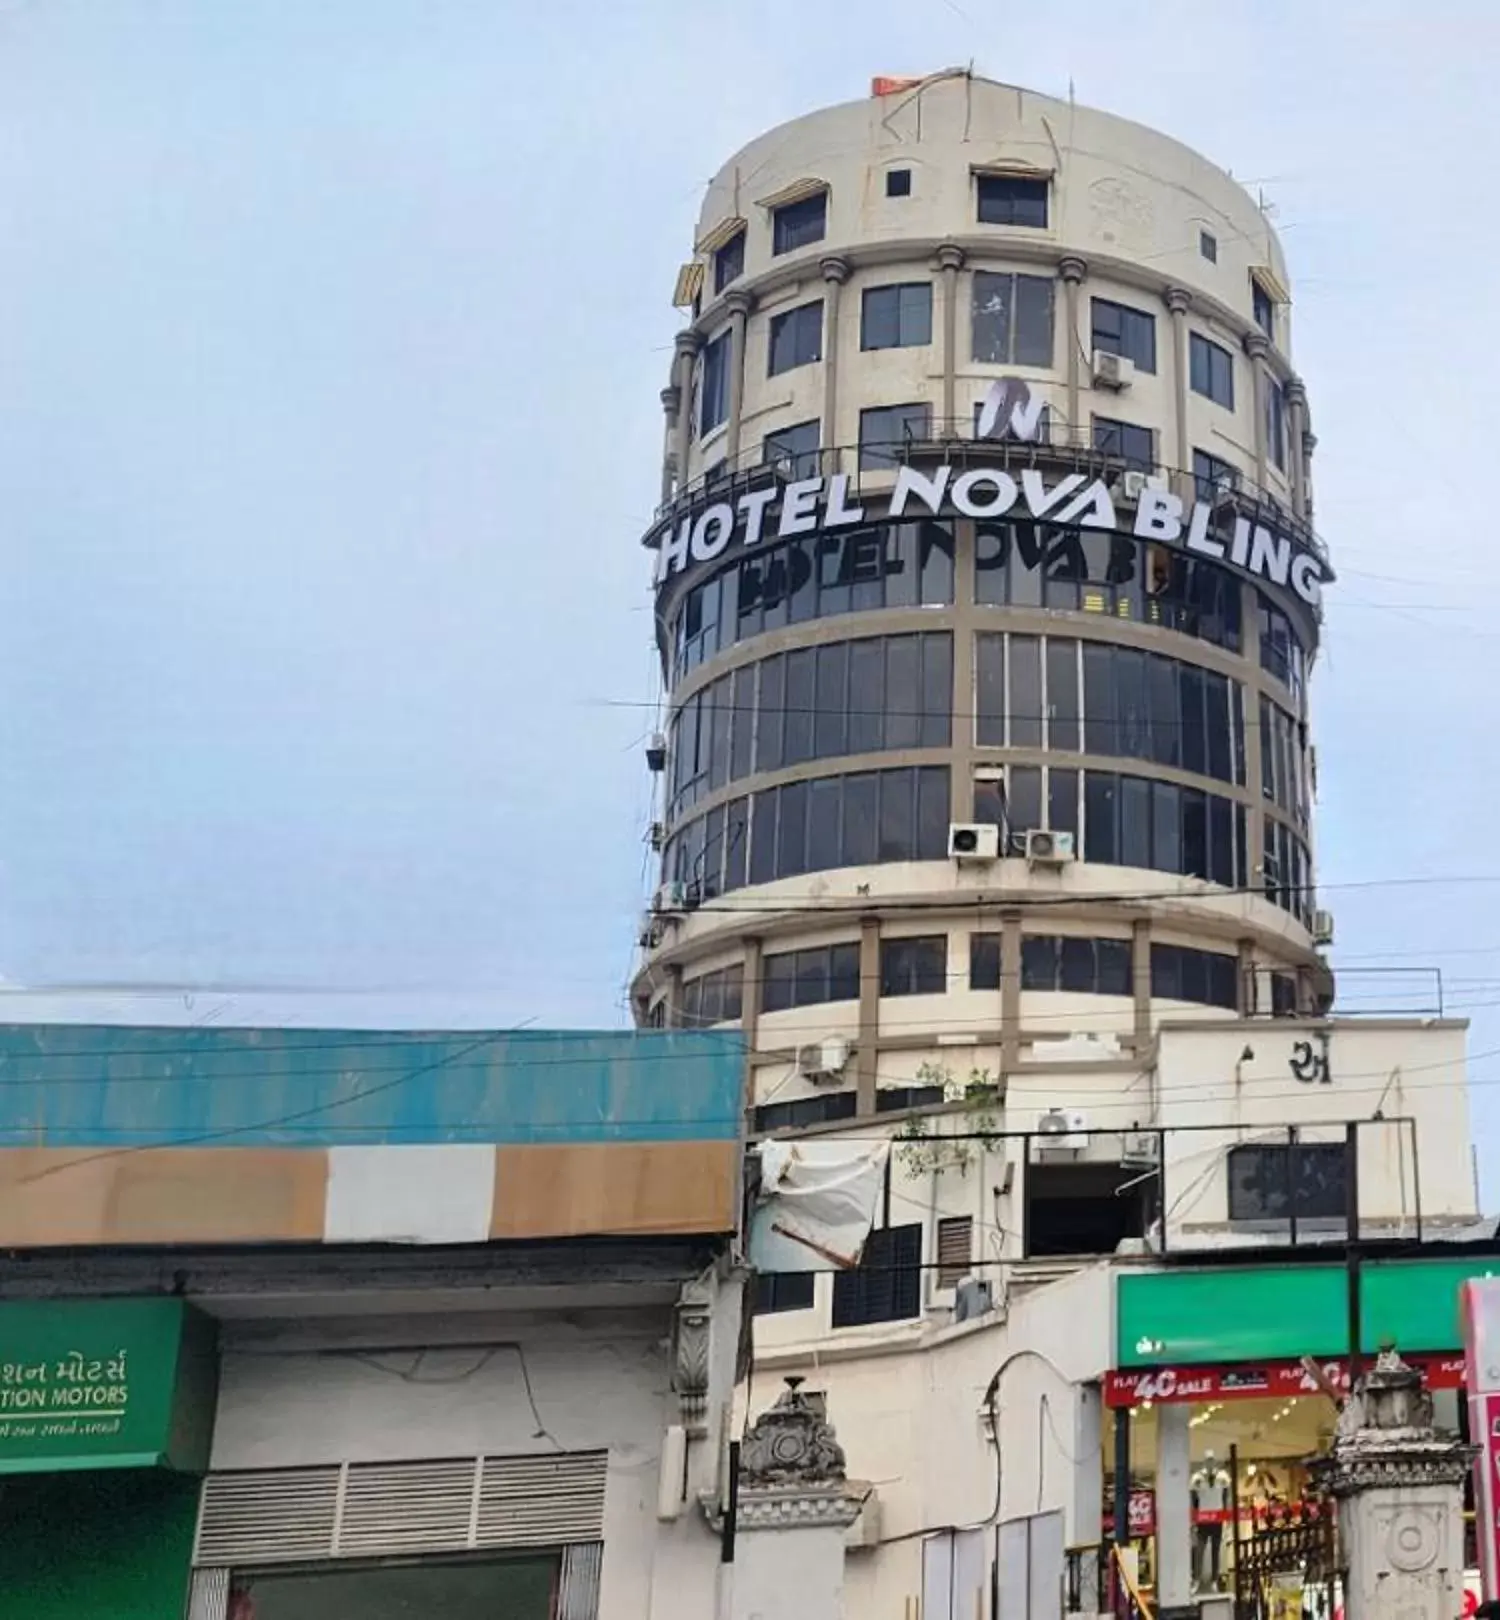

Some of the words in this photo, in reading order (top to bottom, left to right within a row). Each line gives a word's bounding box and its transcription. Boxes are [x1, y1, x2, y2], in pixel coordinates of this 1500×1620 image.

[657, 475, 864, 582] HOTEL
[889, 466, 1116, 529] NOVA
[1134, 487, 1326, 605] BLING
[52, 1385, 128, 1405] MOTORS
